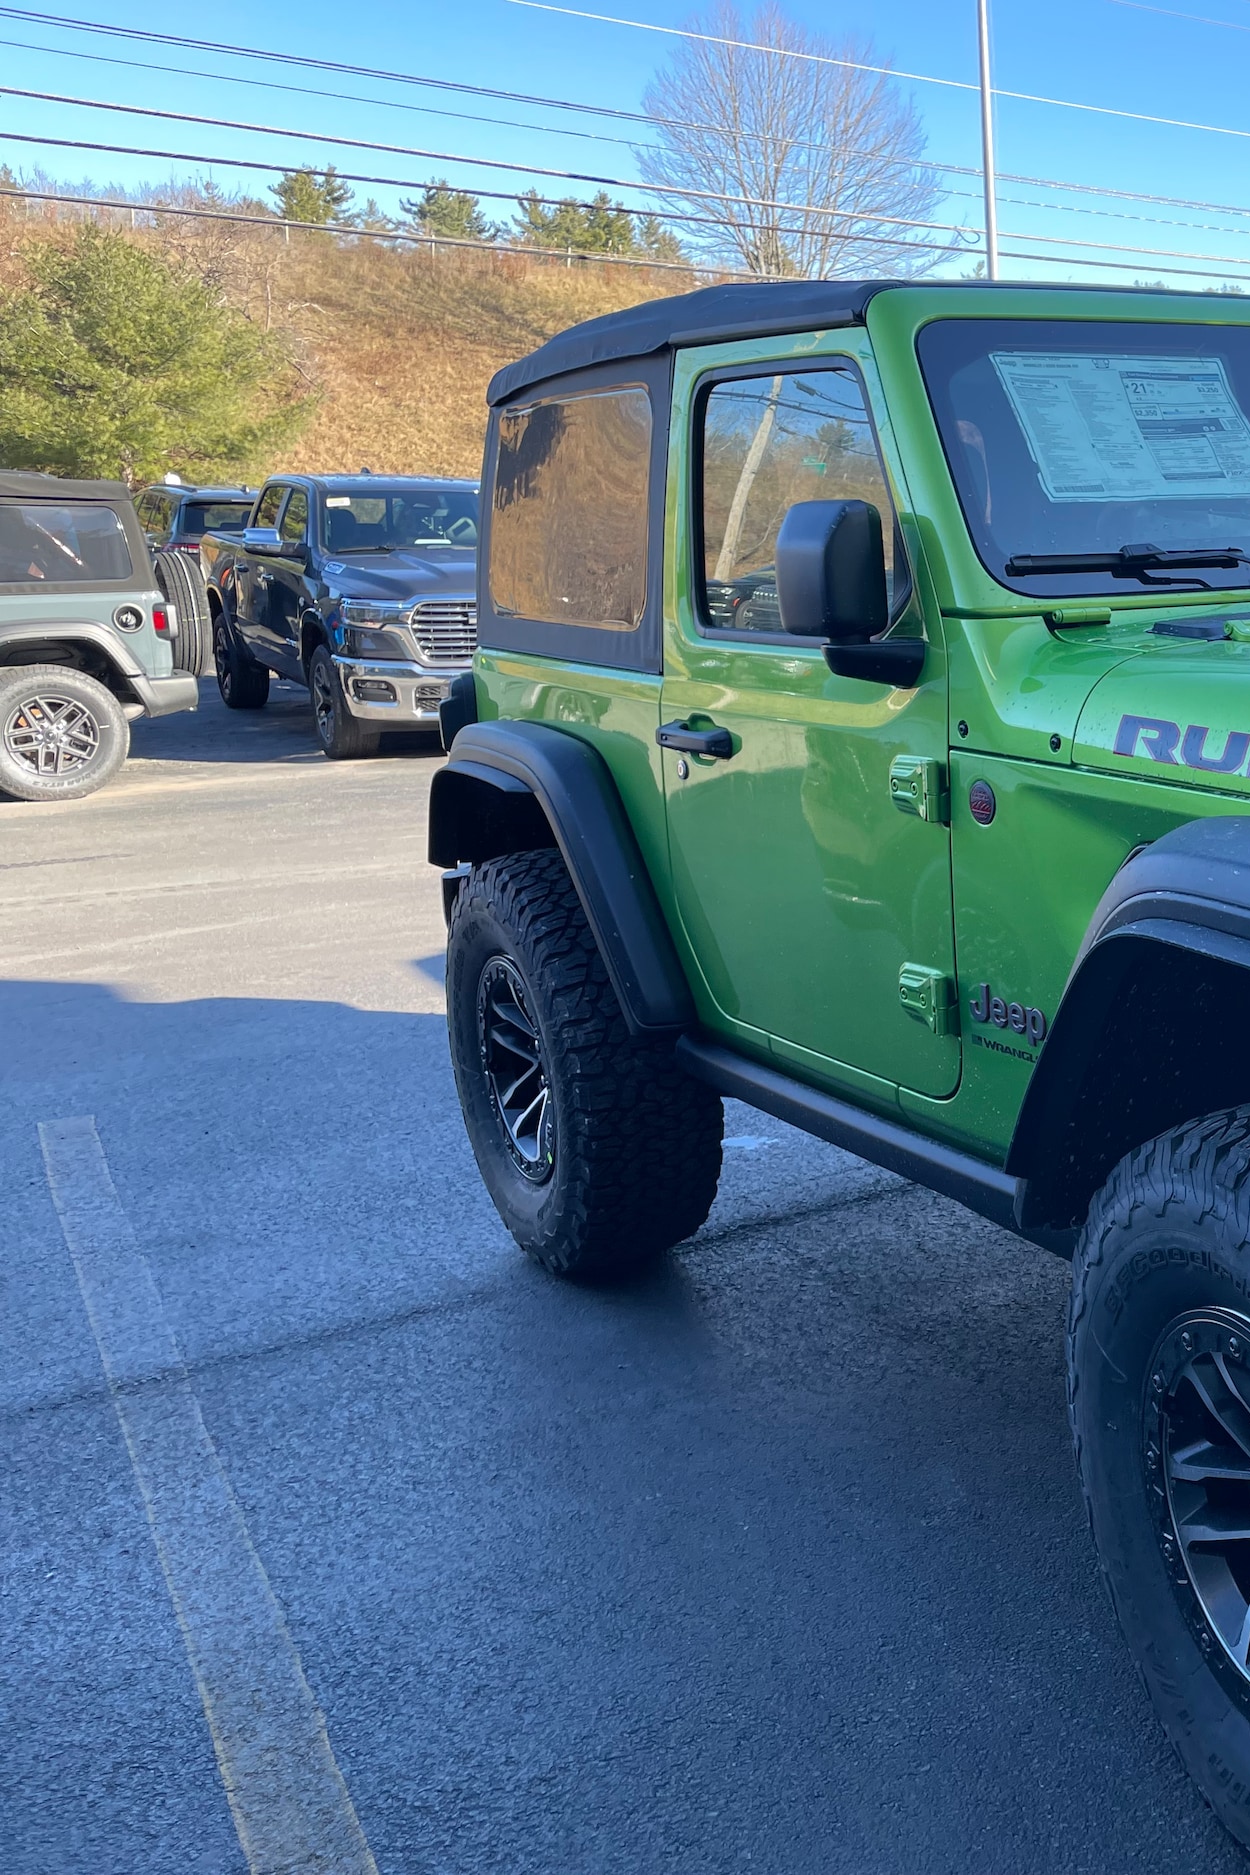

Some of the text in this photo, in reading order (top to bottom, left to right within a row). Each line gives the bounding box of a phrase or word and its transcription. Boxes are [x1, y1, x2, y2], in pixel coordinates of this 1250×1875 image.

[1131, 383, 1147, 394] 21
[969, 982, 1047, 1047] Jeep
[983, 1037, 1039, 1063] WRANGL
